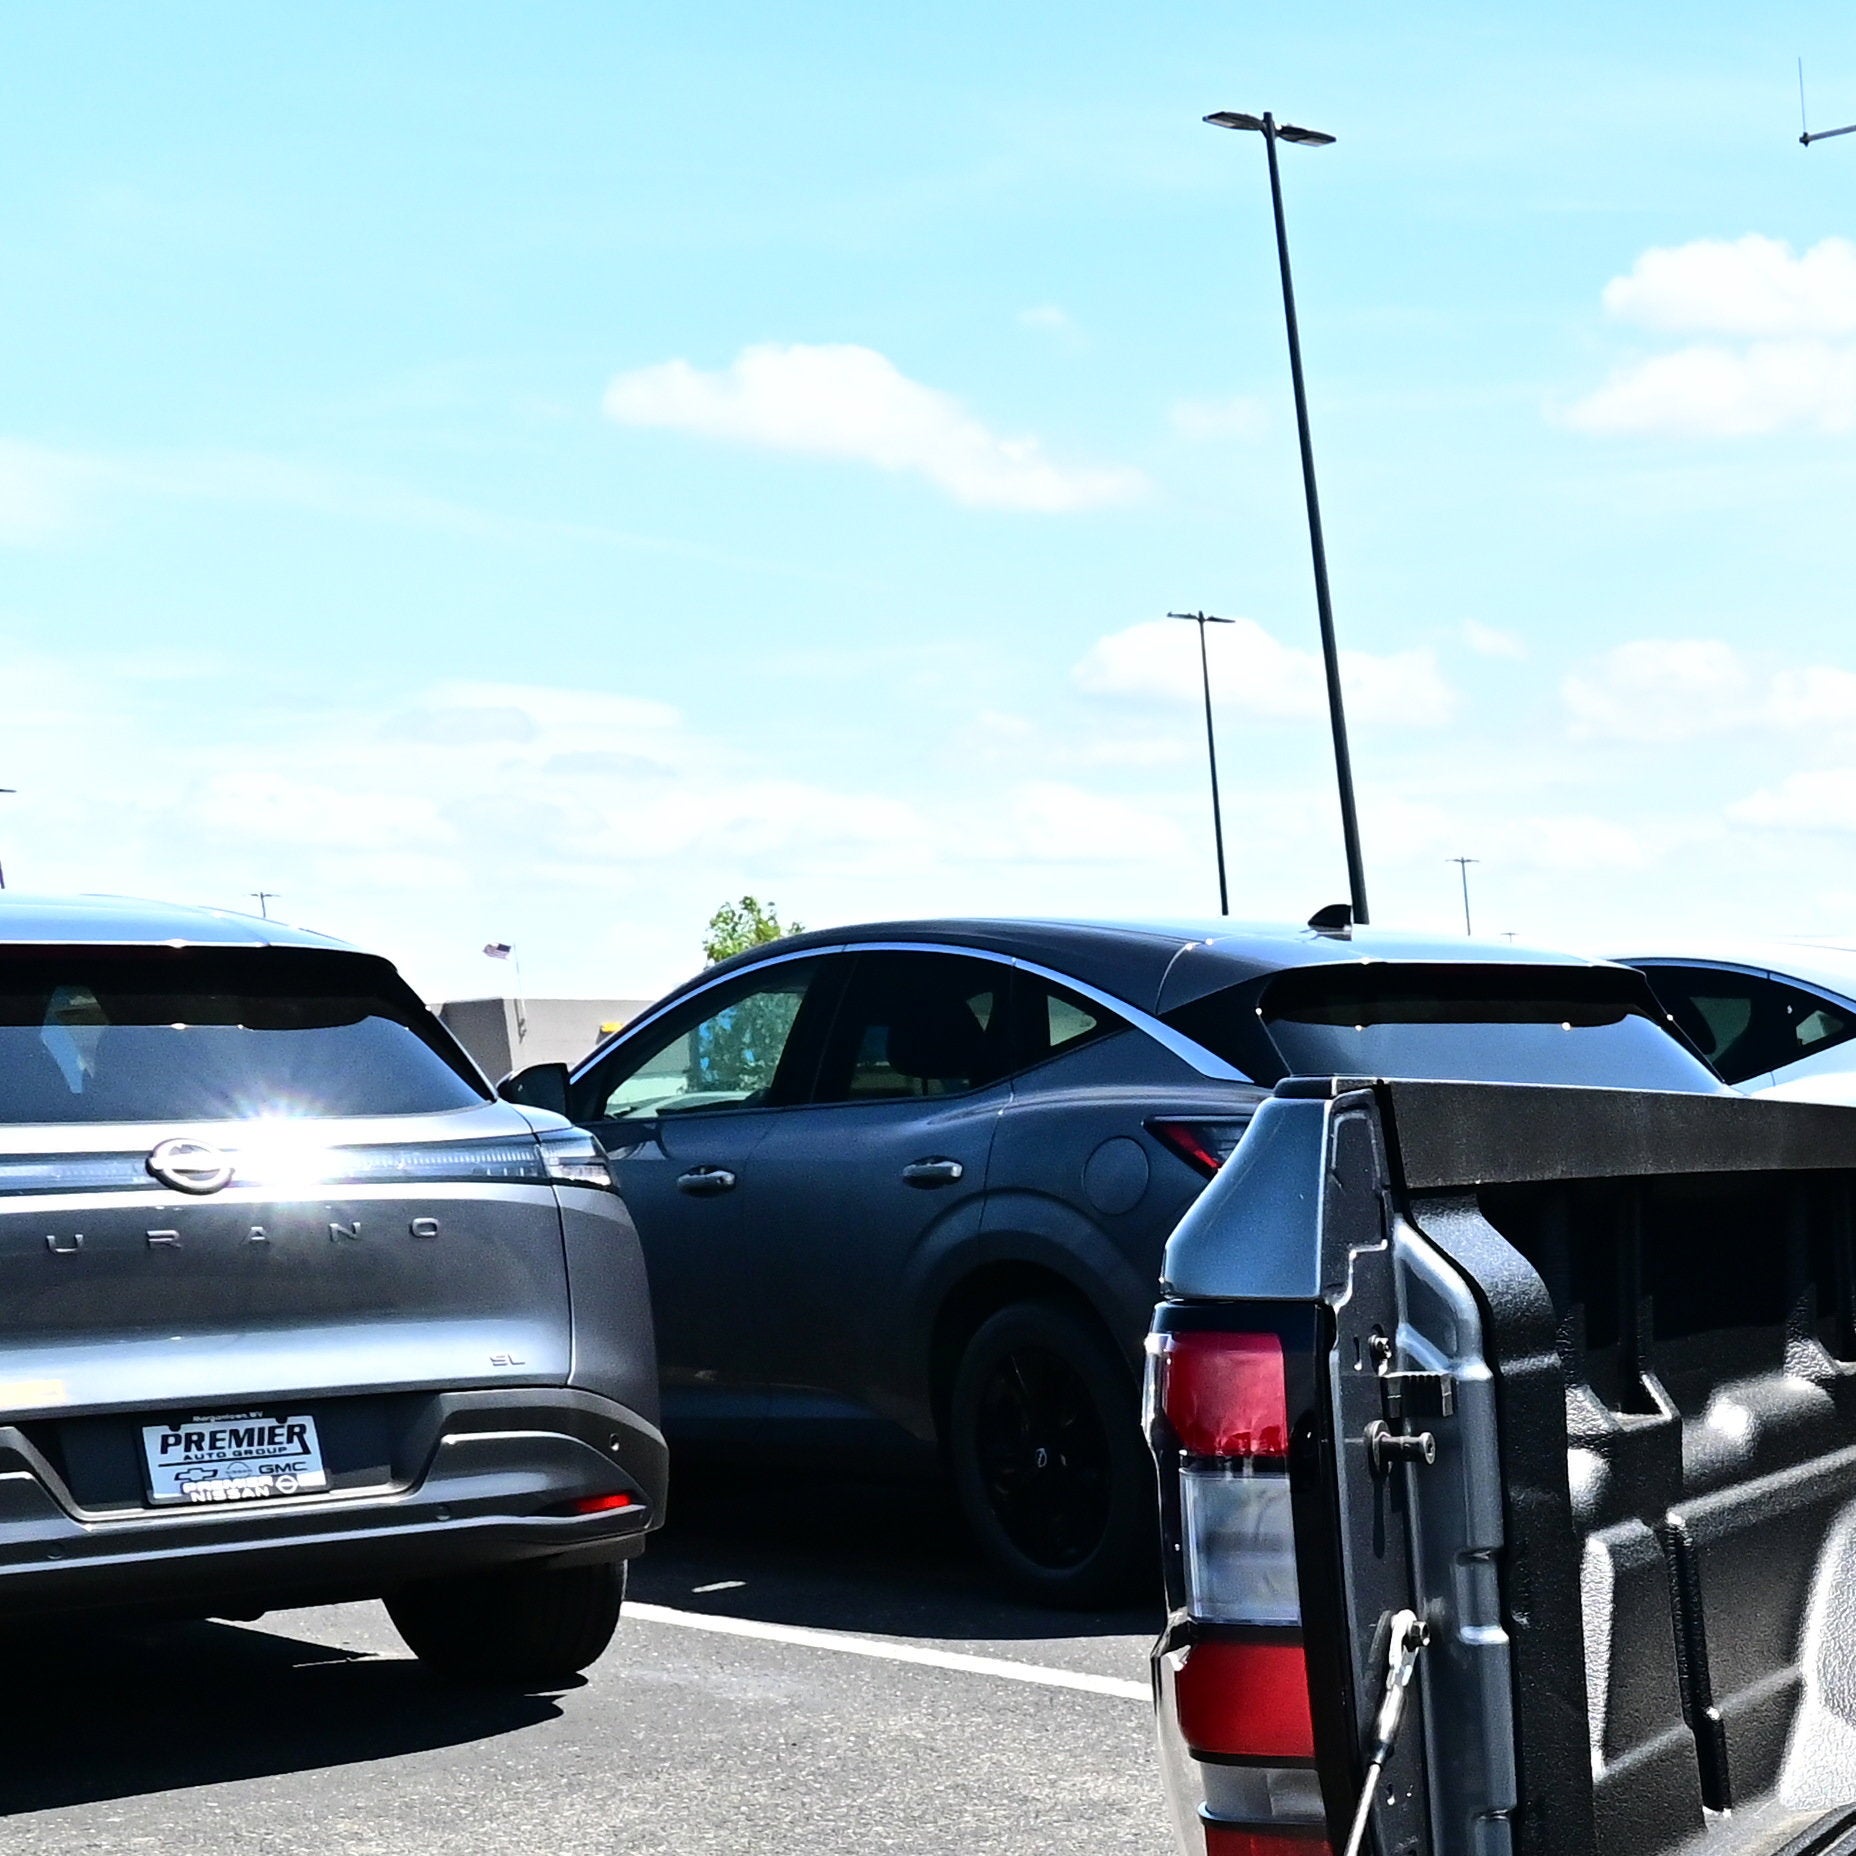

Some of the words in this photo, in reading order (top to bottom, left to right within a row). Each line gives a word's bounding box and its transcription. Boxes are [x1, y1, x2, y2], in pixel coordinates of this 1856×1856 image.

[489, 1353, 526, 1366] SL
[160, 1423, 312, 1455] PREMIER
[183, 1451, 225, 1461] AUTO
[231, 1446, 288, 1457] GROUP
[258, 1461, 308, 1475] GMC
[190, 1485, 270, 1502] NISSAN
